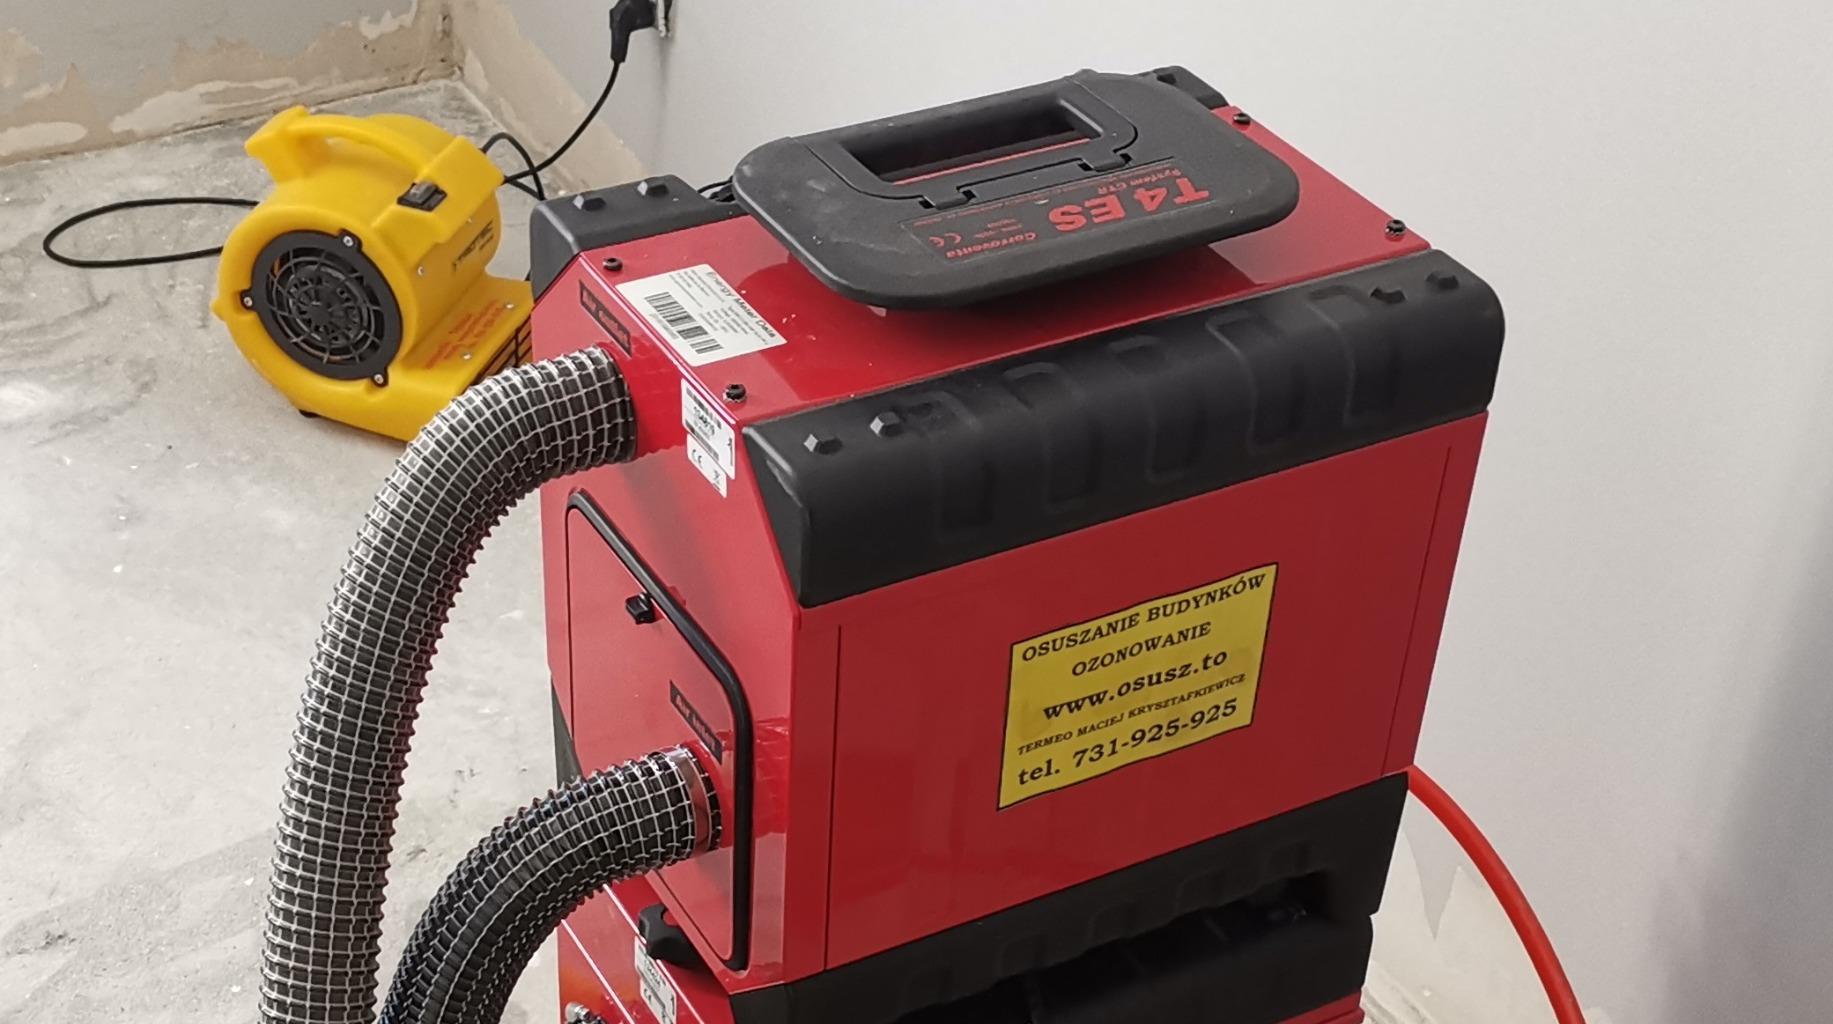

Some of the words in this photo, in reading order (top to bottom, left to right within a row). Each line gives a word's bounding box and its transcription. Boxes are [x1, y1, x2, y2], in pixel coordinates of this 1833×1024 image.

[1048, 193, 1126, 232] ES
[1133, 176, 1210, 213] T4
[946, 231, 1037, 258] Corroventa
[733, 297, 758, 319] Meter
[755, 319, 777, 338] Data
[1021, 612, 1140, 662] OSUSZANIE
[1146, 573, 1266, 623] BUDYNKÓW
[1071, 621, 1211, 677] OZONOWANIE
[1042, 650, 1228, 720] www.osusz.to
[1017, 730, 1073, 756] TERMEO
[1077, 713, 1125, 738] MACIEJ
[1127, 673, 1246, 718] KRYSZTAFKIEWICZ
[1018, 759, 1060, 785] tel.
[1072, 698, 1238, 768] 731-925-925
